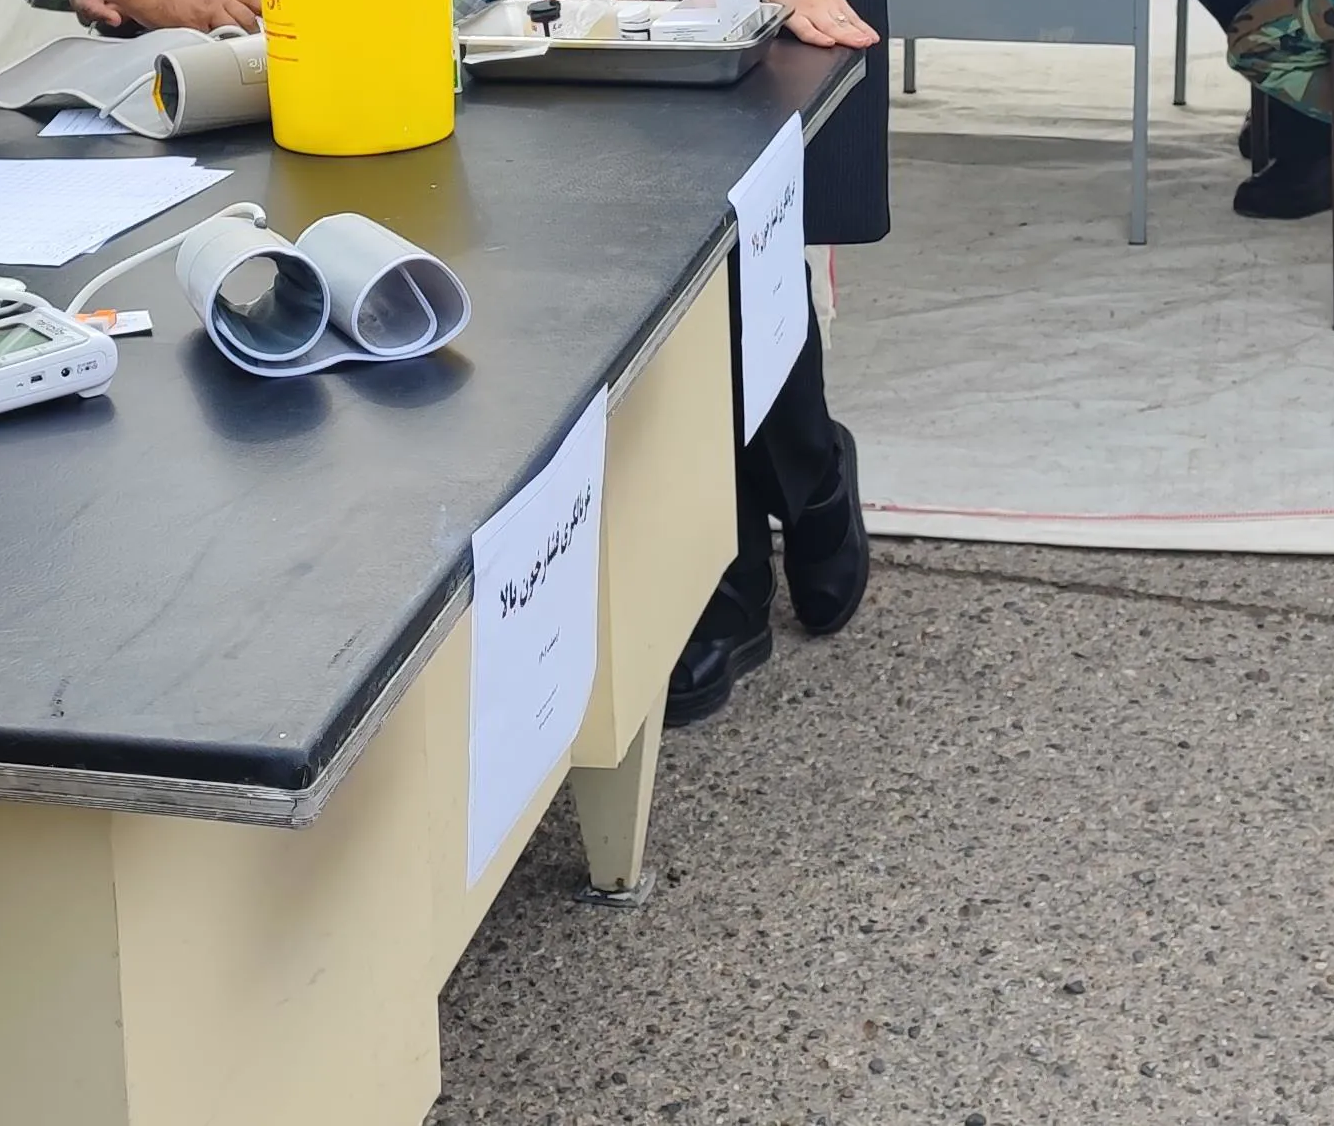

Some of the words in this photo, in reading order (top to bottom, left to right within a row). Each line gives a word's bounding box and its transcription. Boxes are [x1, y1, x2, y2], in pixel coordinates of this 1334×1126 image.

[560, 477, 591, 555] غربالگری
[519, 549, 542, 608] خون
[540, 522, 560, 586] فشار
[500, 578, 517, 619] بالا
